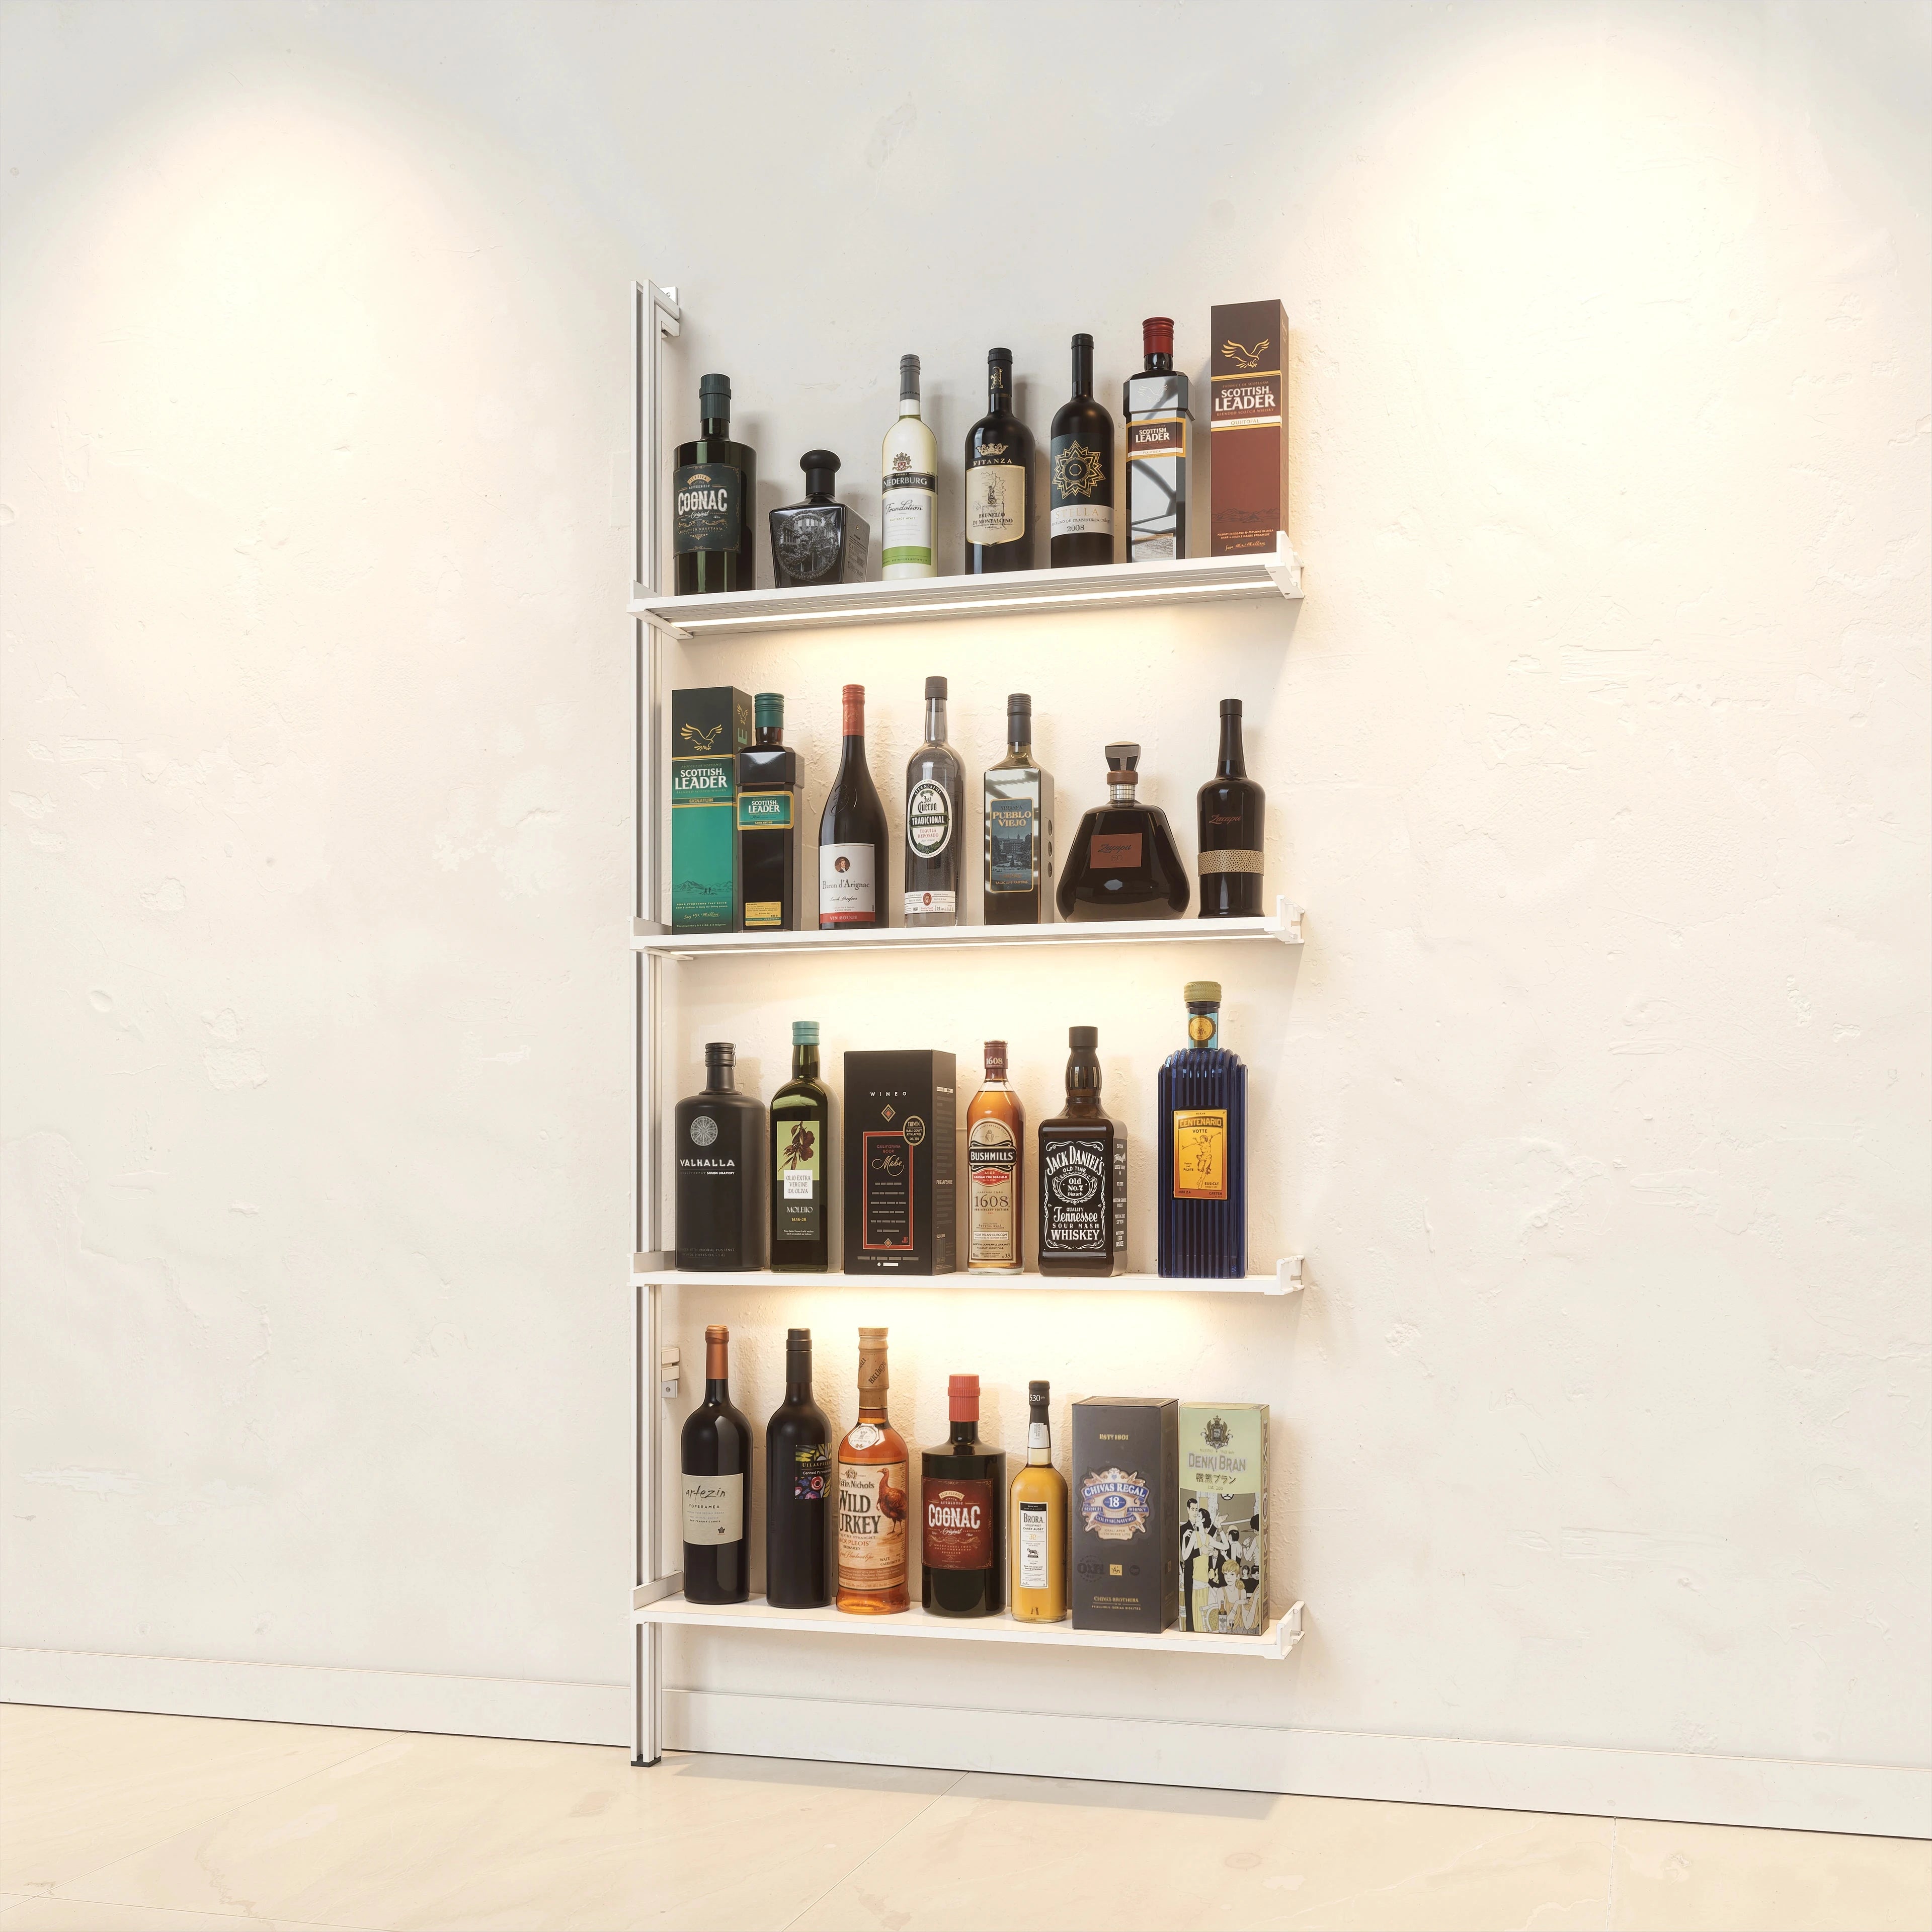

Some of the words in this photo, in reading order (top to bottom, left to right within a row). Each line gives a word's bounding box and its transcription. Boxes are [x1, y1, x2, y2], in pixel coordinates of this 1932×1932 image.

[1221, 385, 1269, 398] SCOTTISH
[1215, 394, 1276, 412] LEADER
[1136, 432, 1170, 443] LEADER
[883, 477, 927, 488] NEDERBURG
[678, 489, 728, 515] COGNAC
[886, 499, 923, 515] Foundation
[1056, 507, 1099, 519] STELLA
[680, 768, 722, 777] SCOTTISH
[675, 775, 728, 790] LEADER
[748, 805, 780, 813] LEADER
[993, 811, 1031, 819] PUEBLO
[912, 816, 945, 826] TRADICIONAL
[998, 819, 1026, 827] VIEJO
[823, 880, 837, 889] Baron
[839, 879, 870, 890] d'Arignac
[986, 1056, 1003, 1065] 1608
[1179, 1117, 1222, 1128] CENTENARIO
[971, 1151, 1013, 1161] BUSHMILLS
[1046, 1151, 1069, 1175] JACK
[1069, 1146, 1104, 1175] DANIEL'S
[680, 1159, 735, 1167] VALHALLA
[975, 1194, 1008, 1208] 1608
[1054, 1206, 1098, 1222] Tennessee
[1051, 1230, 1100, 1240] WHISKEY
[1189, 1453, 1217, 1472] DENKI
[1219, 1455, 1246, 1473] BRAN
[686, 1485, 726, 1499] artezin
[1084, 1483, 1115, 1497] CHIVAS
[1116, 1483, 1146, 1498] REGAL
[839, 1489, 871, 1513] WILD
[1109, 1497, 1120, 1508] 18
[928, 1504, 981, 1530] COGNAC
[1023, 1513, 1043, 1523] BRORA
[1095, 1515, 1109, 1524] GOLD
